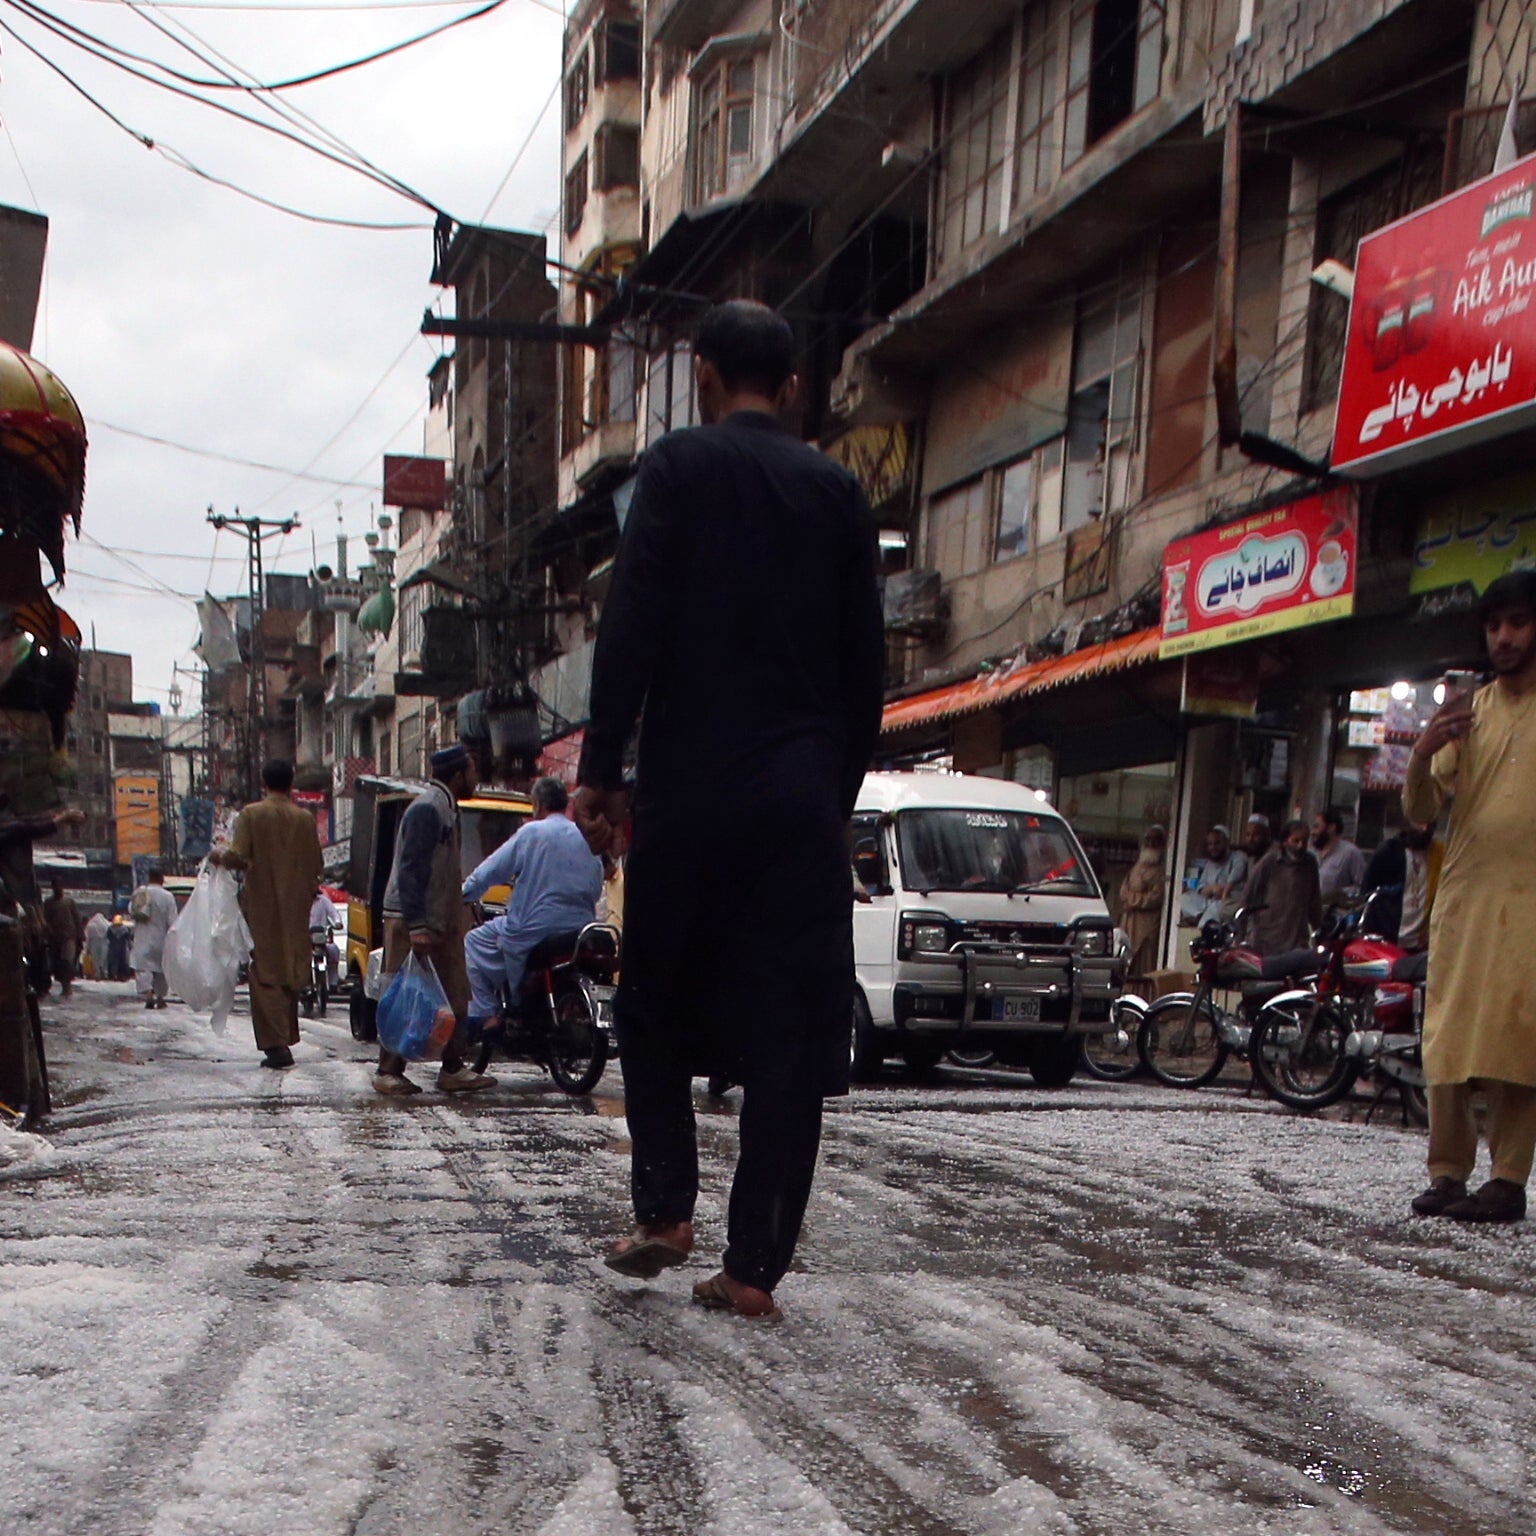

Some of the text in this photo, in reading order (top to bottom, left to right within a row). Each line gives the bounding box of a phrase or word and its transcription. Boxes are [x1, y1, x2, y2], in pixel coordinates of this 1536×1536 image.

[1452, 265, 1493, 316] Aik
[1359, 377, 1421, 444] چائے
[1274, 509, 1287, 524] TEA
[1207, 546, 1295, 607] انصاف چائے
